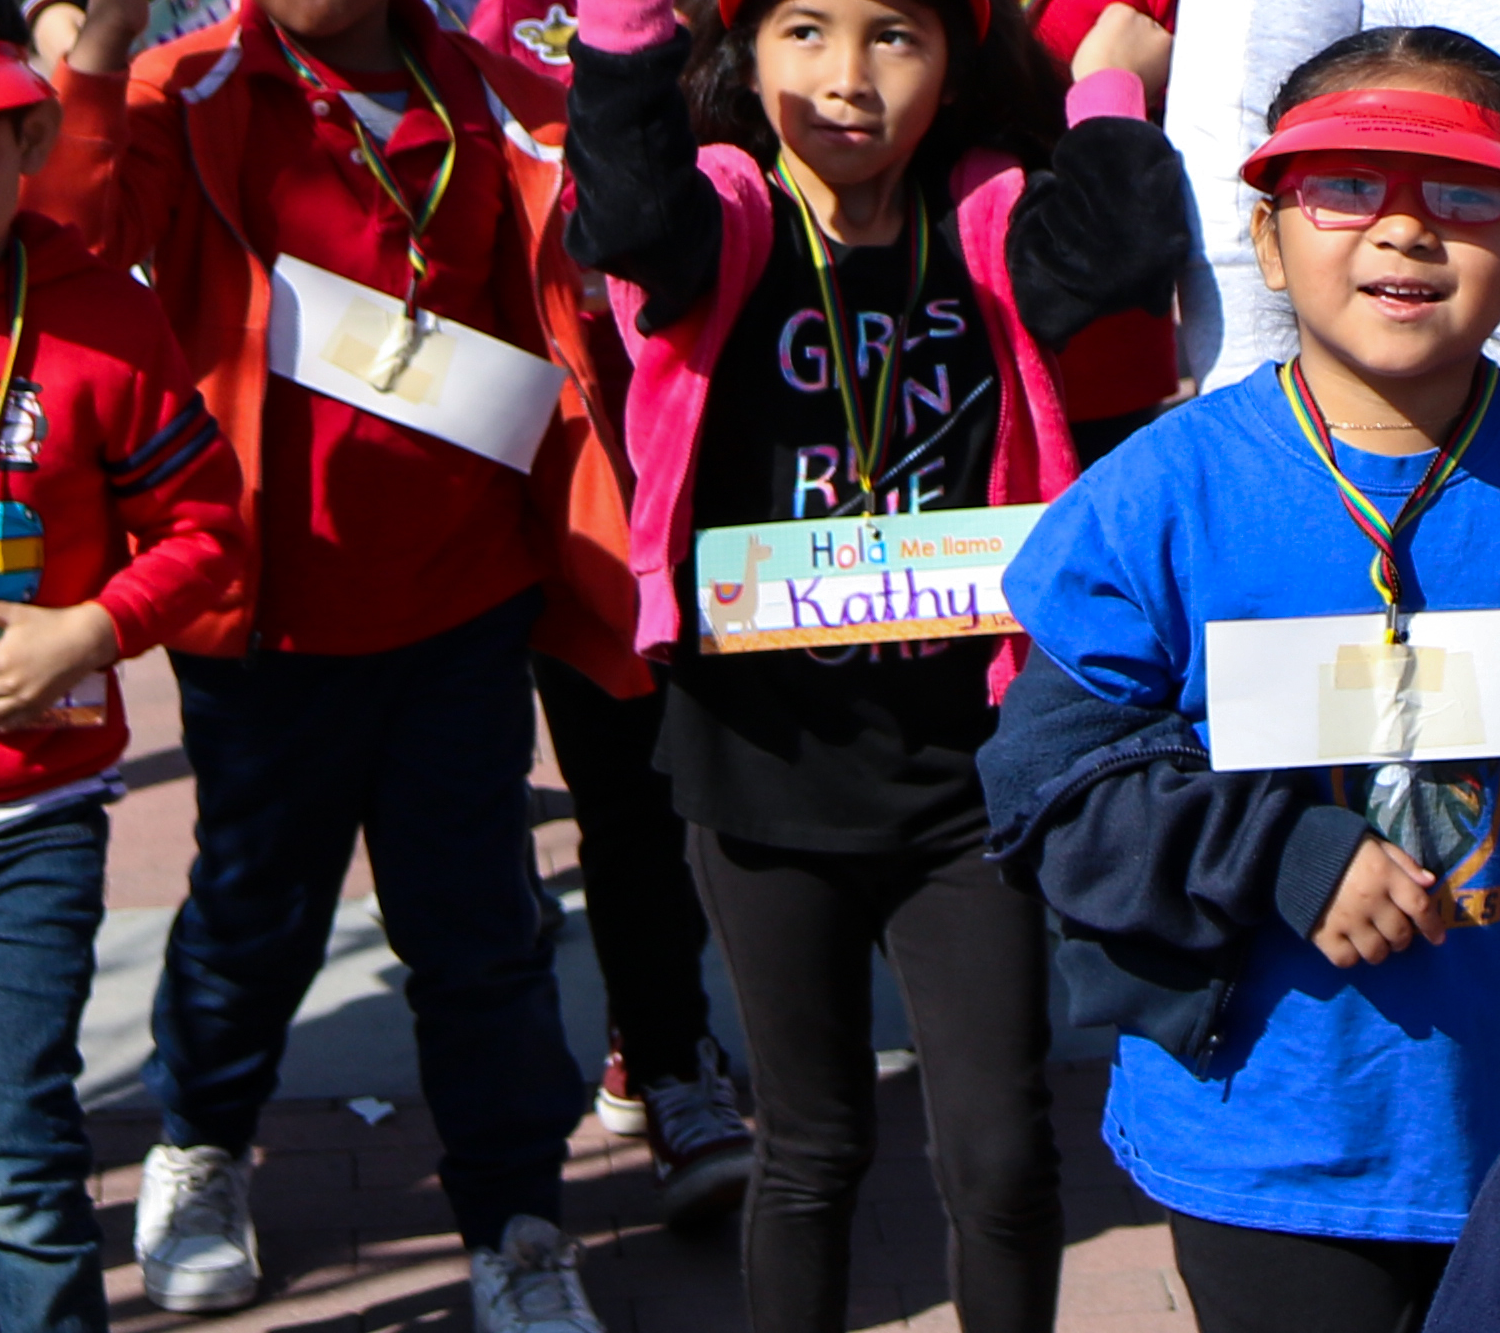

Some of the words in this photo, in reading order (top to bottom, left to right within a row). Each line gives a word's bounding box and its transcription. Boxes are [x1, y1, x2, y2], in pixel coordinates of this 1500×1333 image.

[811, 525, 887, 569] Hola
[901, 539, 936, 559] Me
[943, 536, 1004, 555] llamo
[786, 567, 980, 630] Kathy
